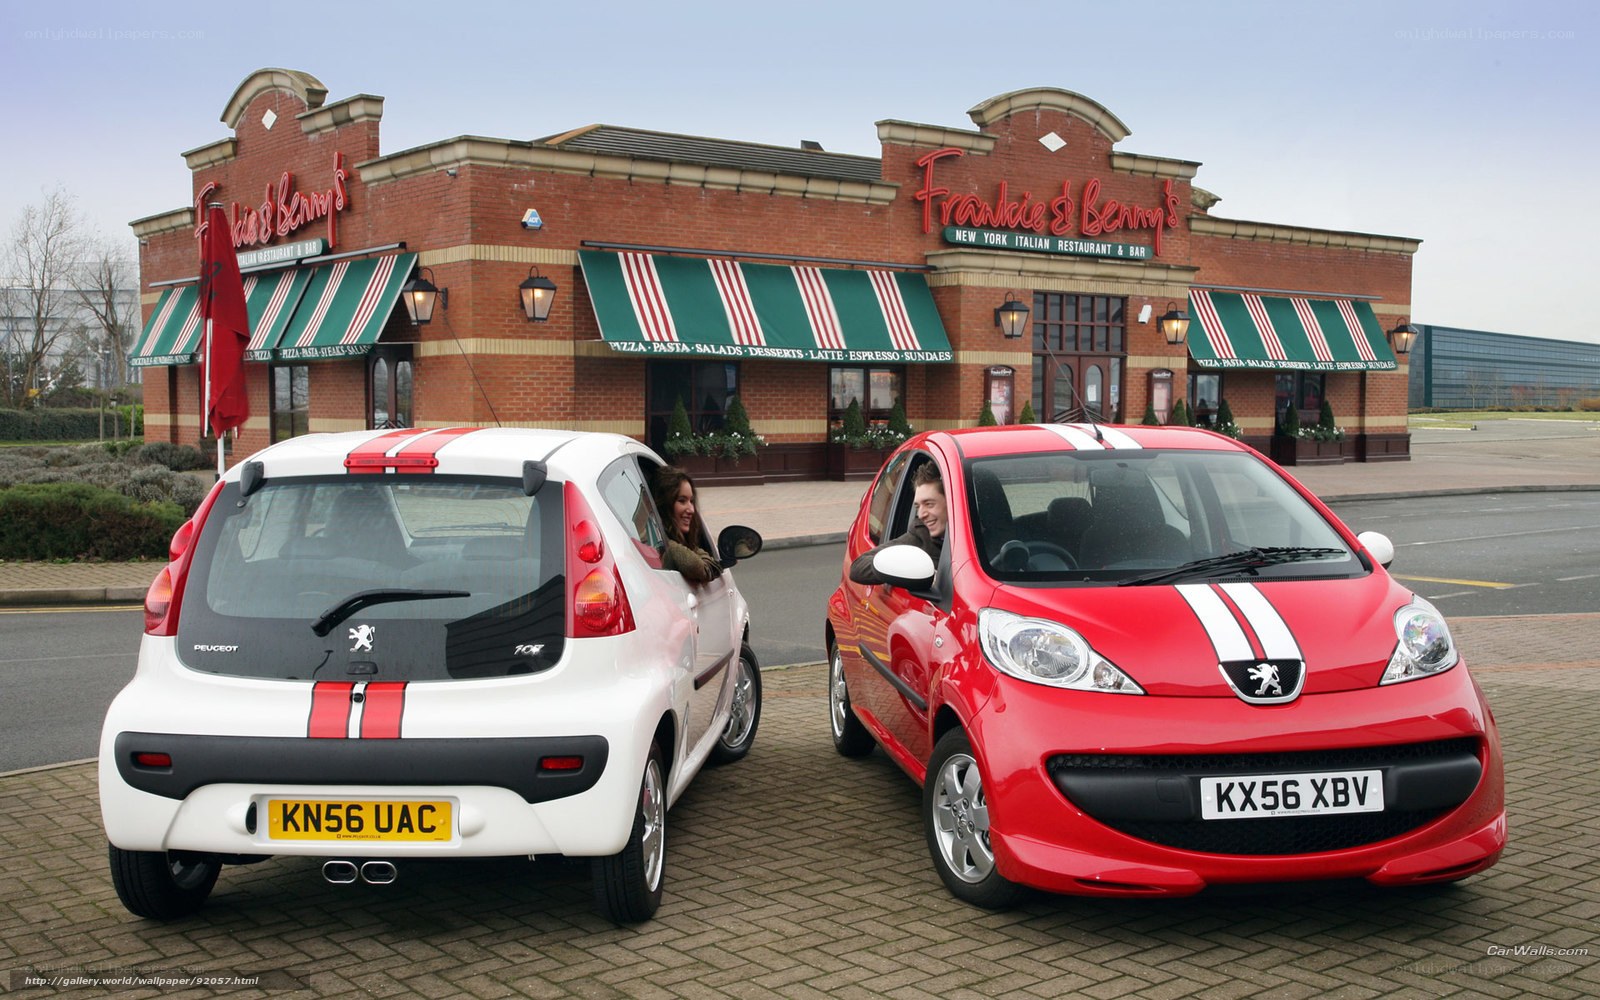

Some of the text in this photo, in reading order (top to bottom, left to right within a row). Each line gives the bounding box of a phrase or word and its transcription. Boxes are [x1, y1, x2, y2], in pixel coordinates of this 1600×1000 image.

[276, 152, 349, 248] Benny's
[914, 147, 1046, 234] Frankie
[1081, 177, 1181, 257] Benny's
[258, 246, 294, 262] RESTAURANT
[305, 241, 317, 255] BAR
[955, 229, 1146, 257] NEW YORK ITALIAN RESTAURANT & BAR
[283, 348, 300, 358] PIZZA
[301, 347, 320, 358] PASTA
[321, 345, 345, 357] STEAKS
[608, 342, 951, 361] PIZZA PASTA SALADS DESSERTS LATTE ESPRESSO SUNDAES
[1222, 359, 1245, 367] PASTA
[1246, 360, 1275, 368] SALADS
[1279, 361, 1311, 369] DESSERTS
[1313, 361, 1334, 370] LATTE
[1368, 361, 1396, 369] SUNDAES
[194, 644, 239, 653] PEUGEOT
[514, 644, 545, 655] 107
[1215, 776, 1369, 812] KX56 XBV
[282, 803, 437, 833] KN56 UAC
